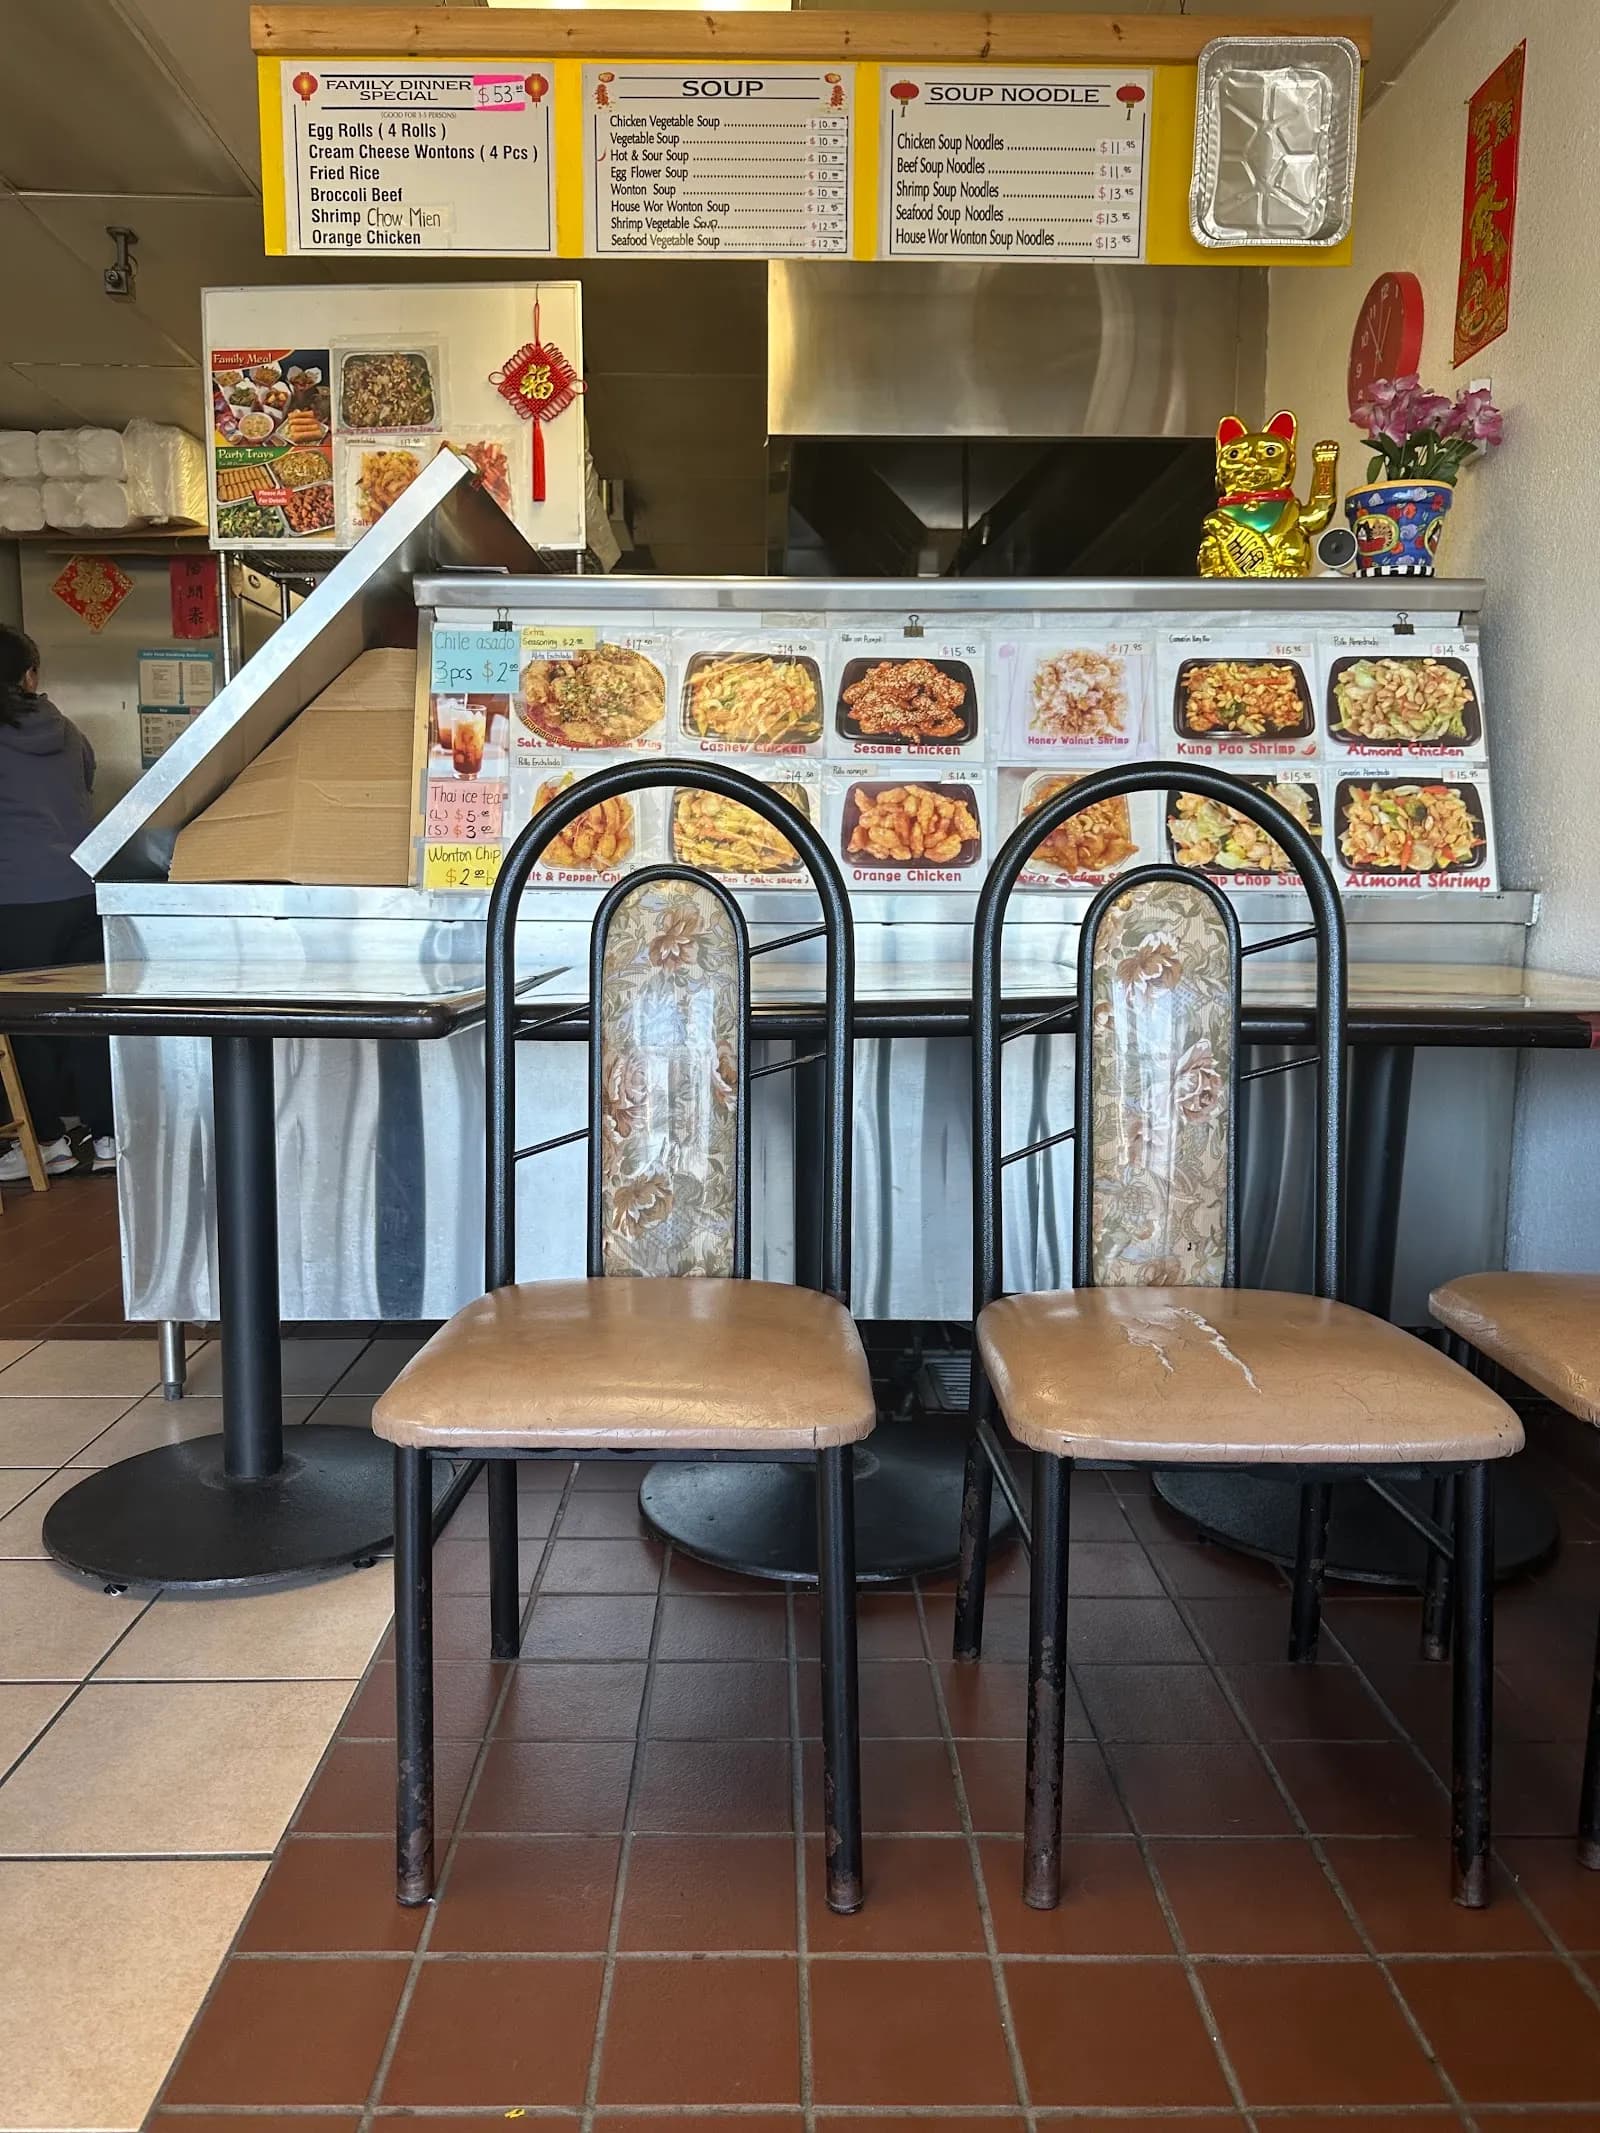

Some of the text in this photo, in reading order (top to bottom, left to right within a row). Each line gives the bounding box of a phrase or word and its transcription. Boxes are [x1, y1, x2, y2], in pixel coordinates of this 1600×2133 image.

[326, 80, 472, 91] FAMILY DINNER
[682, 80, 764, 97] SOUP
[359, 91, 438, 101] SPECIAL
[930, 86, 1100, 103] SOUP NOODLE
[308, 123, 333, 140] Egg
[338, 123, 373, 138] Rolls
[388, 124, 397, 138] 4
[402, 123, 437, 139] Rolls
[610, 115, 720, 132] Chicken Vegetable Soup
[610, 132, 680, 149] Vegetable Soup
[897, 133, 1004, 154] Chicken Soup Noodles
[308, 145, 354, 160] Cream
[360, 145, 410, 160] Cheese
[414, 145, 475, 160] Wontons
[489, 146, 499, 159] 4
[503, 145, 529, 160] Pcs
[610, 150, 689, 166] Hot & Sour Soup
[310, 165, 380, 181] Fried Rice
[611, 166, 688, 183] Egg Flower Soup
[897, 156, 985, 178] Beef Soup Noodles
[311, 187, 402, 203] Broccoli Beef
[610, 183, 676, 199] Wonton Soup
[896, 181, 999, 202] Shrimp Soup Noodles
[611, 200, 730, 216] House Wor Wonton Soup
[896, 204, 1004, 226] Seafood Soup Noodles
[311, 208, 441, 228] Shrimp Chow Mien
[611, 216, 718, 232] Shrimp Vegetable Soup
[312, 230, 421, 248] Orange Chicken
[611, 233, 720, 250] Seafood Vegetable Soup
[896, 228, 1055, 250] House Wor Wonton Soup Noodles
[213, 352, 272, 366] Family Meal
[218, 448, 274, 461] Party Trays
[352, 518, 369, 527] Salt
[434, 630, 515, 650] Chile asado
[517, 737, 542, 748] Salt
[700, 740, 749, 753] Cashew
[854, 743, 961, 756] Sesame Chicken
[1028, 736, 1130, 747] Honey Walnut Shrimp
[1177, 742, 1296, 756] Kung Pao Shrimp
[1346, 742, 1465, 757] Almond Chicken
[431, 786, 457, 803] Thai
[462, 789, 478, 803] ice
[428, 846, 472, 863] Wonton
[545, 872, 553, 881] &
[559, 872, 598, 883] Pepper
[853, 869, 961, 884] Orange Chicken
[1234, 873, 1271, 887] Chop
[1278, 873, 1304, 886] Sue
[1345, 871, 1491, 890] Almond Shrimp
